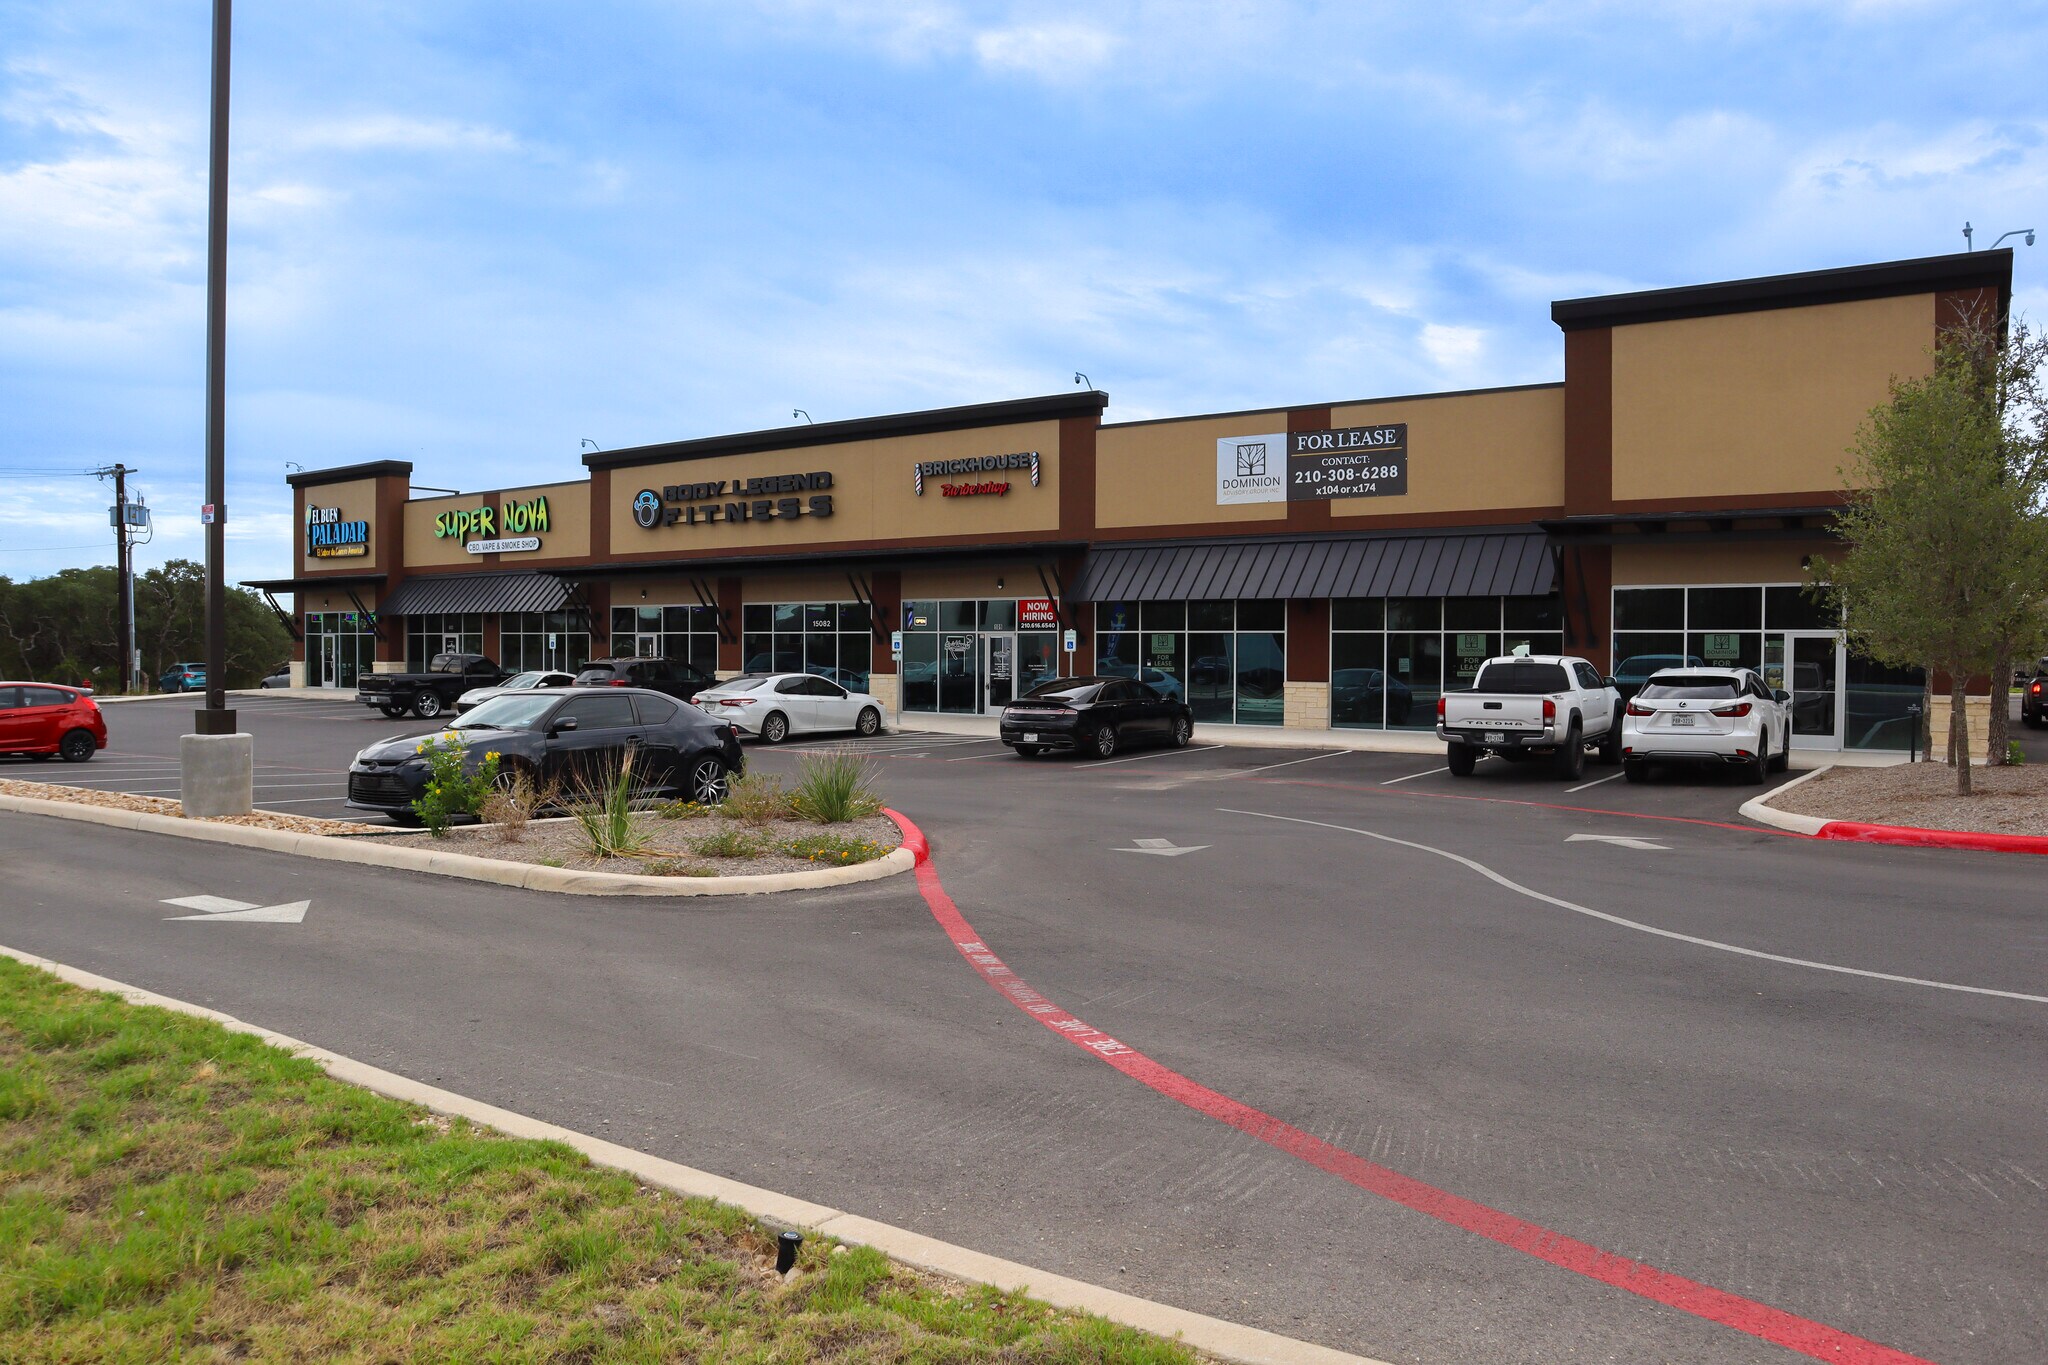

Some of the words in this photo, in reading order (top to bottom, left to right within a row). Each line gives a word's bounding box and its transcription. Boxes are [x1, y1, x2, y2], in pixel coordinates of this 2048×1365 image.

[1297, 435, 1335, 451] FOR
[1338, 429, 1396, 448] LEASE
[922, 452, 1030, 476] BRICKHOUSE
[1321, 456, 1370, 466] CONTACT:
[1222, 476, 1281, 489] DOMINION
[1295, 465, 1398, 484] 210-308-6288
[663, 480, 726, 502] BODY
[733, 471, 833, 496] LEGEND
[941, 480, 1010, 497] Barbershop
[1316, 485, 1339, 495] x104
[1352, 483, 1376, 494] x174
[312, 509, 321, 524] EL
[321, 507, 339, 523] BUEN
[663, 495, 833, 527] FITNESS
[434, 506, 496, 547] SUPER
[503, 495, 550, 533] NOVA
[312, 520, 366, 546] PALADAR
[482, 542, 495, 551] VAPE
[501, 541, 521, 550] SMOKE
[521, 539, 537, 548] SHOP
[1027, 602, 1049, 611] NOW
[812, 620, 831, 628] 15082
[1022, 612, 1054, 621] HIRING
[1049, 1018, 1101, 1037] LANE
[1084, 1038, 1135, 1056] FIRE
